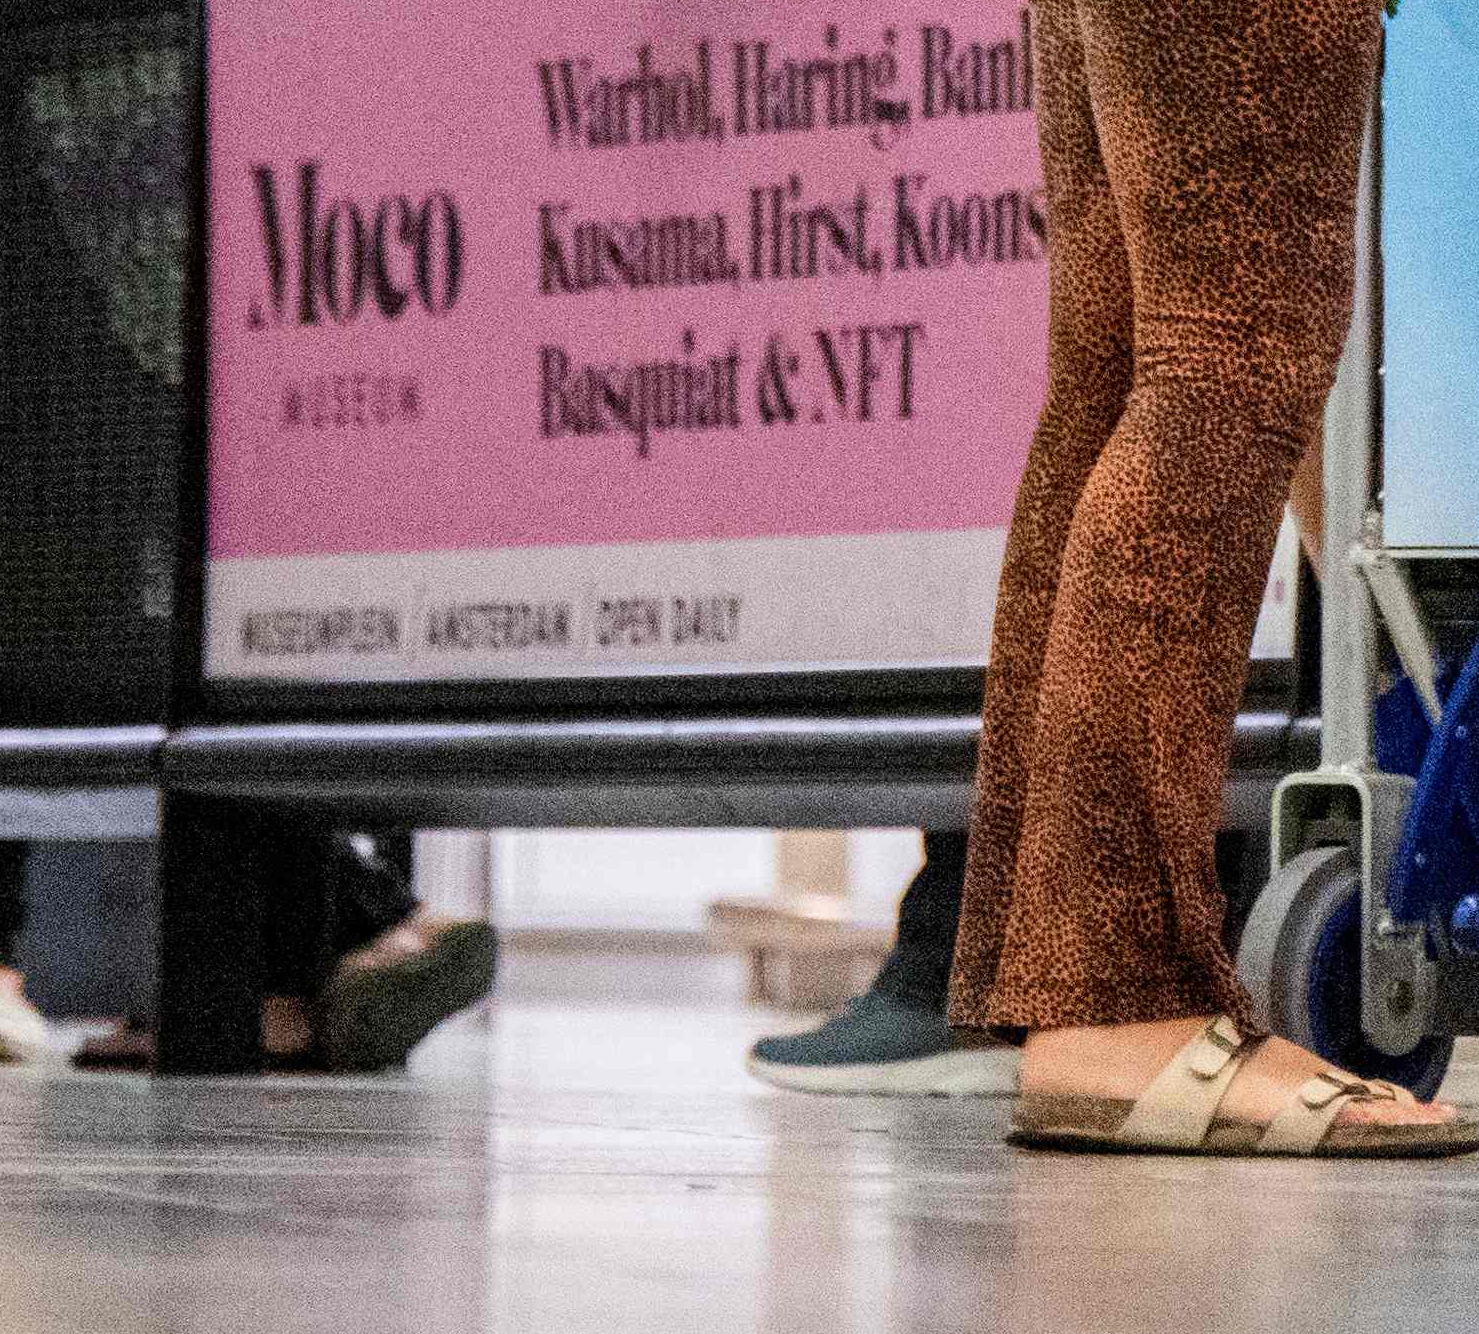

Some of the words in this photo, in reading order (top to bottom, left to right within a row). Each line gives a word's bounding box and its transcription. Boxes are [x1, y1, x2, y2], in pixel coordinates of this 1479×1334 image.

[537, 39, 726, 150] Warhol,
[734, 24, 910, 151] Haring,
[248, 160, 465, 330] Moco
[538, 202, 741, 297] Kusama,
[750, 172, 883, 283] Hirst,
[538, 327, 741, 459] Basquiat
[756, 336, 799, 426] &
[810, 323, 926, 425] NFT
